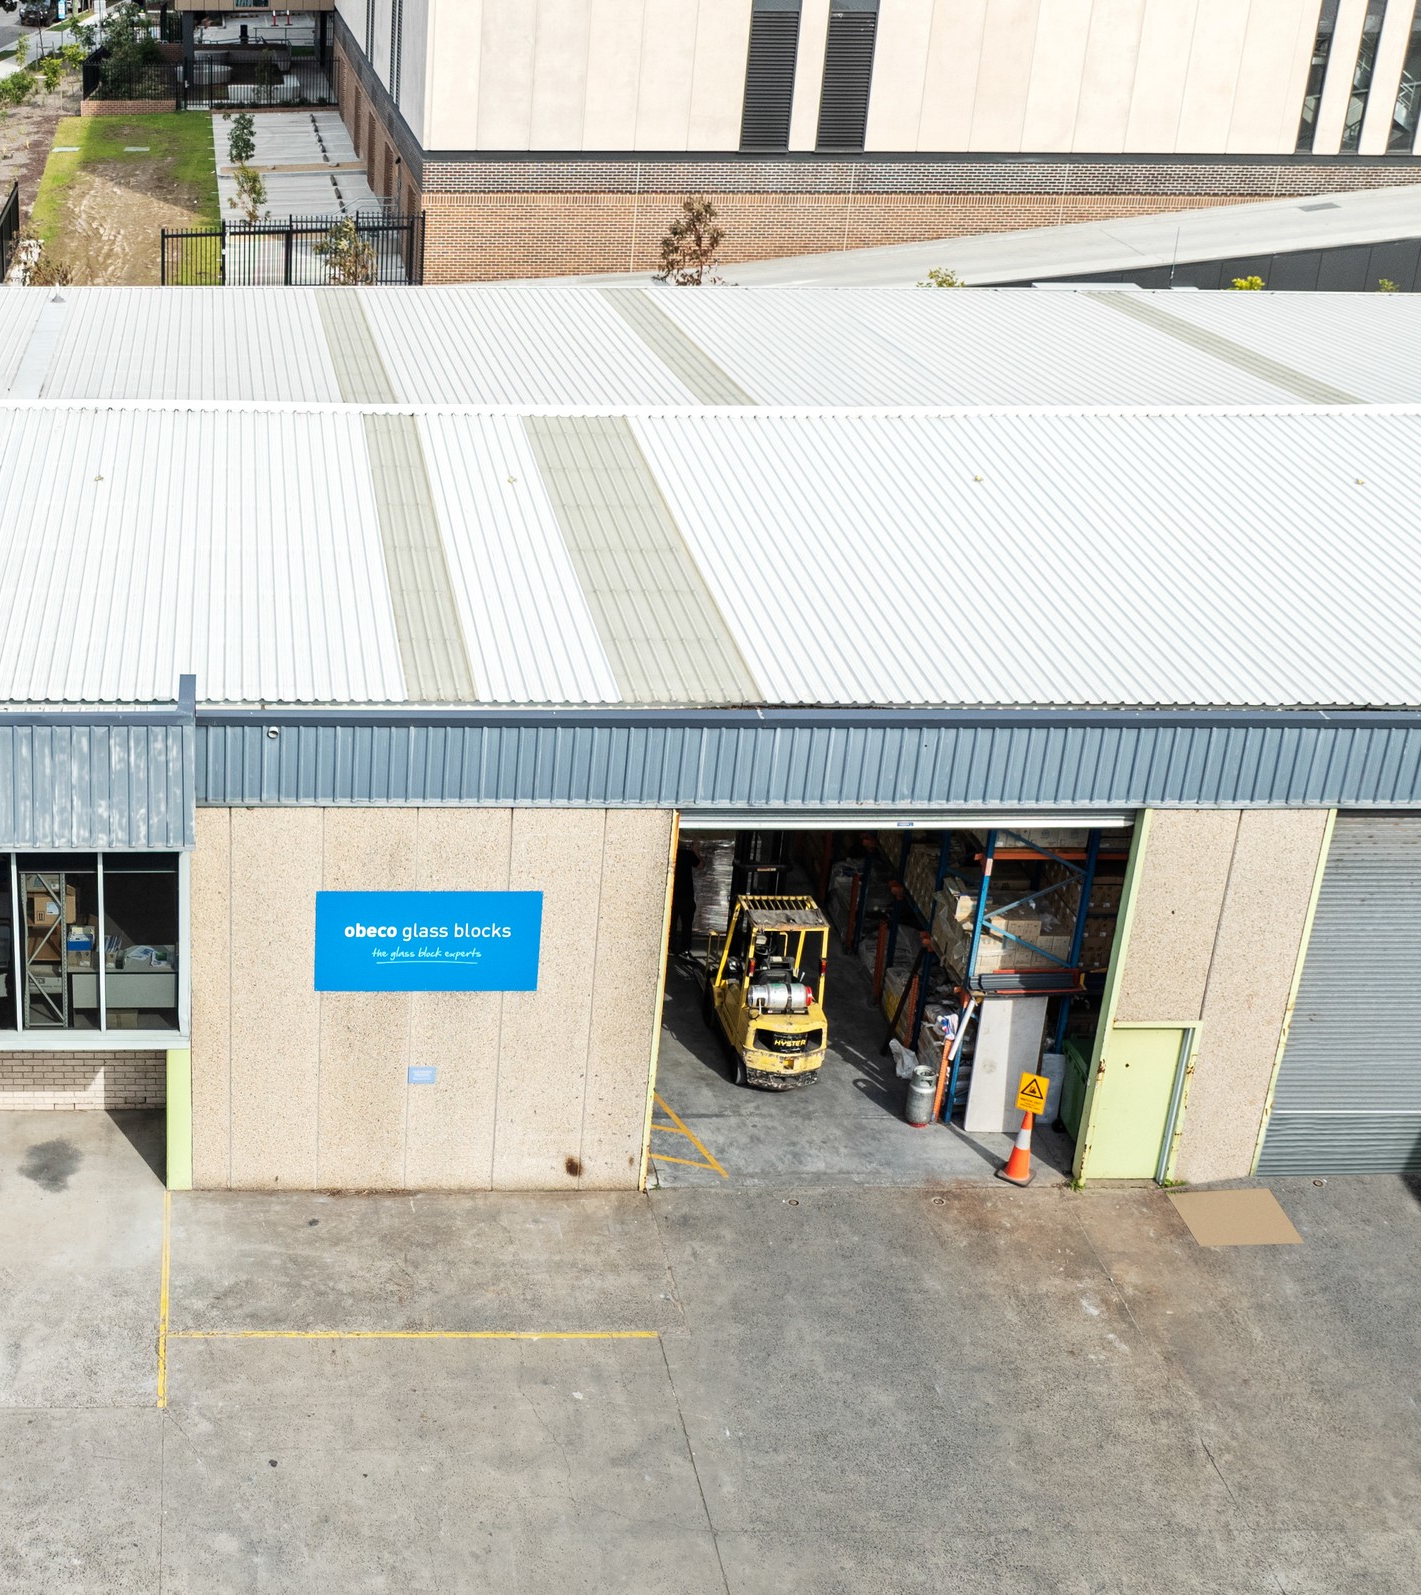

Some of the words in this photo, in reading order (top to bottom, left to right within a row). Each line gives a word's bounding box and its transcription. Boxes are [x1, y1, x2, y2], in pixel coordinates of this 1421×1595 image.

[344, 922, 397, 938] obeco
[402, 923, 449, 942] glass
[454, 923, 512, 938] blocks
[372, 947, 388, 957] the
[390, 946, 415, 960] glass
[418, 946, 442, 958] block
[444, 948, 482, 959] experts
[774, 1039, 807, 1047] HYSTER
